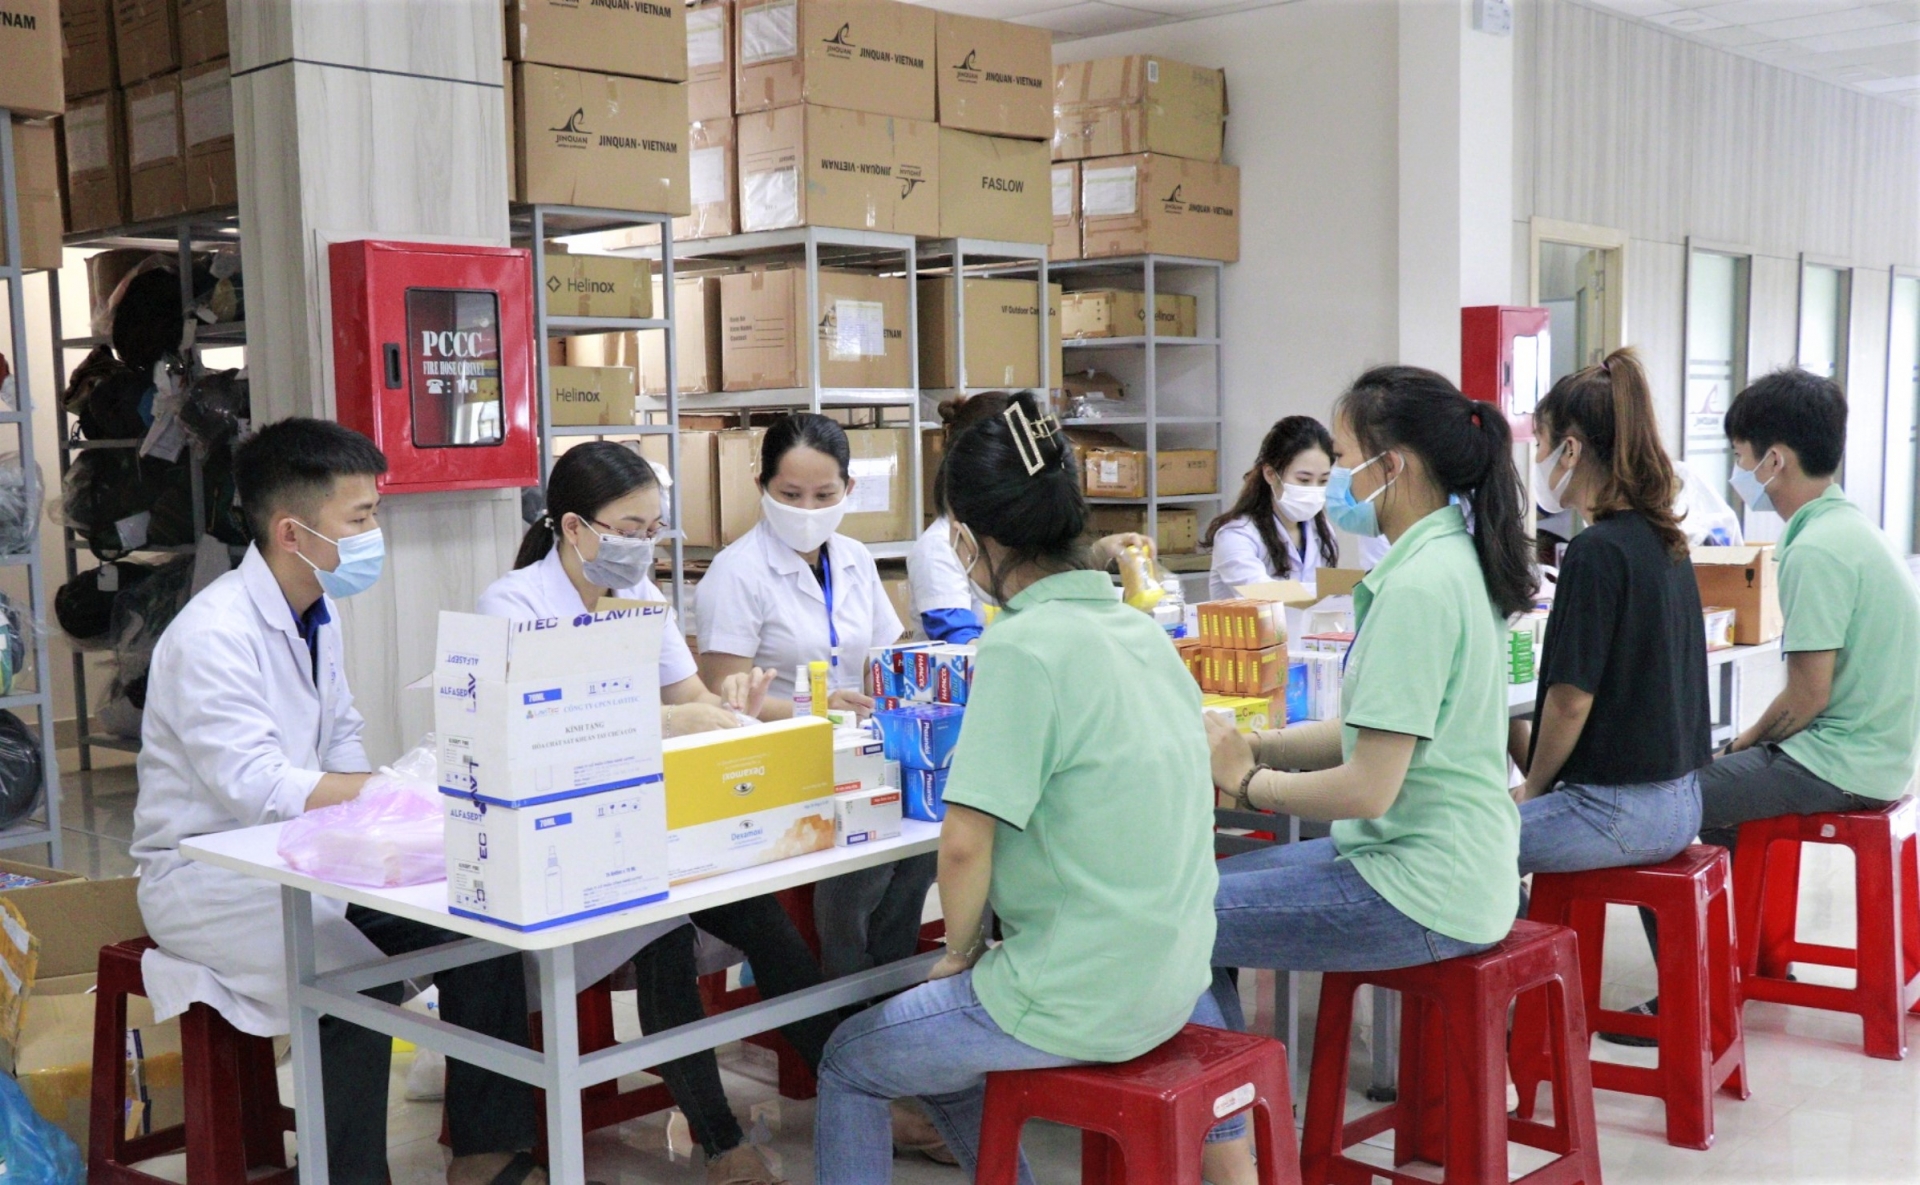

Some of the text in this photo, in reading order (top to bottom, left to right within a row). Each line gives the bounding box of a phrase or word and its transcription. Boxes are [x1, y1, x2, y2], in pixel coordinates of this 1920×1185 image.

[635, 2, 672, 18] VIETNAM
[860, 48, 890, 62] JINQUAN
[894, 53, 924, 69] VIETNAM
[985, 72, 1012, 84] JINQUAN
[1015, 76, 1042, 88] VIETNAM
[556, 135, 588, 144] JINQUAN
[599, 135, 637, 149] JINQUAN
[642, 139, 677, 153] VIETNAM
[821, 159, 856, 173] VIETNAM
[860, 163, 891, 176] JINQUAN
[982, 176, 1024, 193] FASLOW
[568, 278, 615, 293] Helinox
[421, 330, 482, 358] PCCC
[422, 361, 439, 375] FIRE
[440, 361, 457, 375] HOSE
[456, 379, 478, 394] 114
[556, 388, 600, 402] Helinox
[447, 654, 478, 666] ALFASEPT
[722, 766, 765, 783] Dexamoxi
[450, 808, 482, 821] ALFASEPT
[731, 828, 763, 841] Dexamoxi
